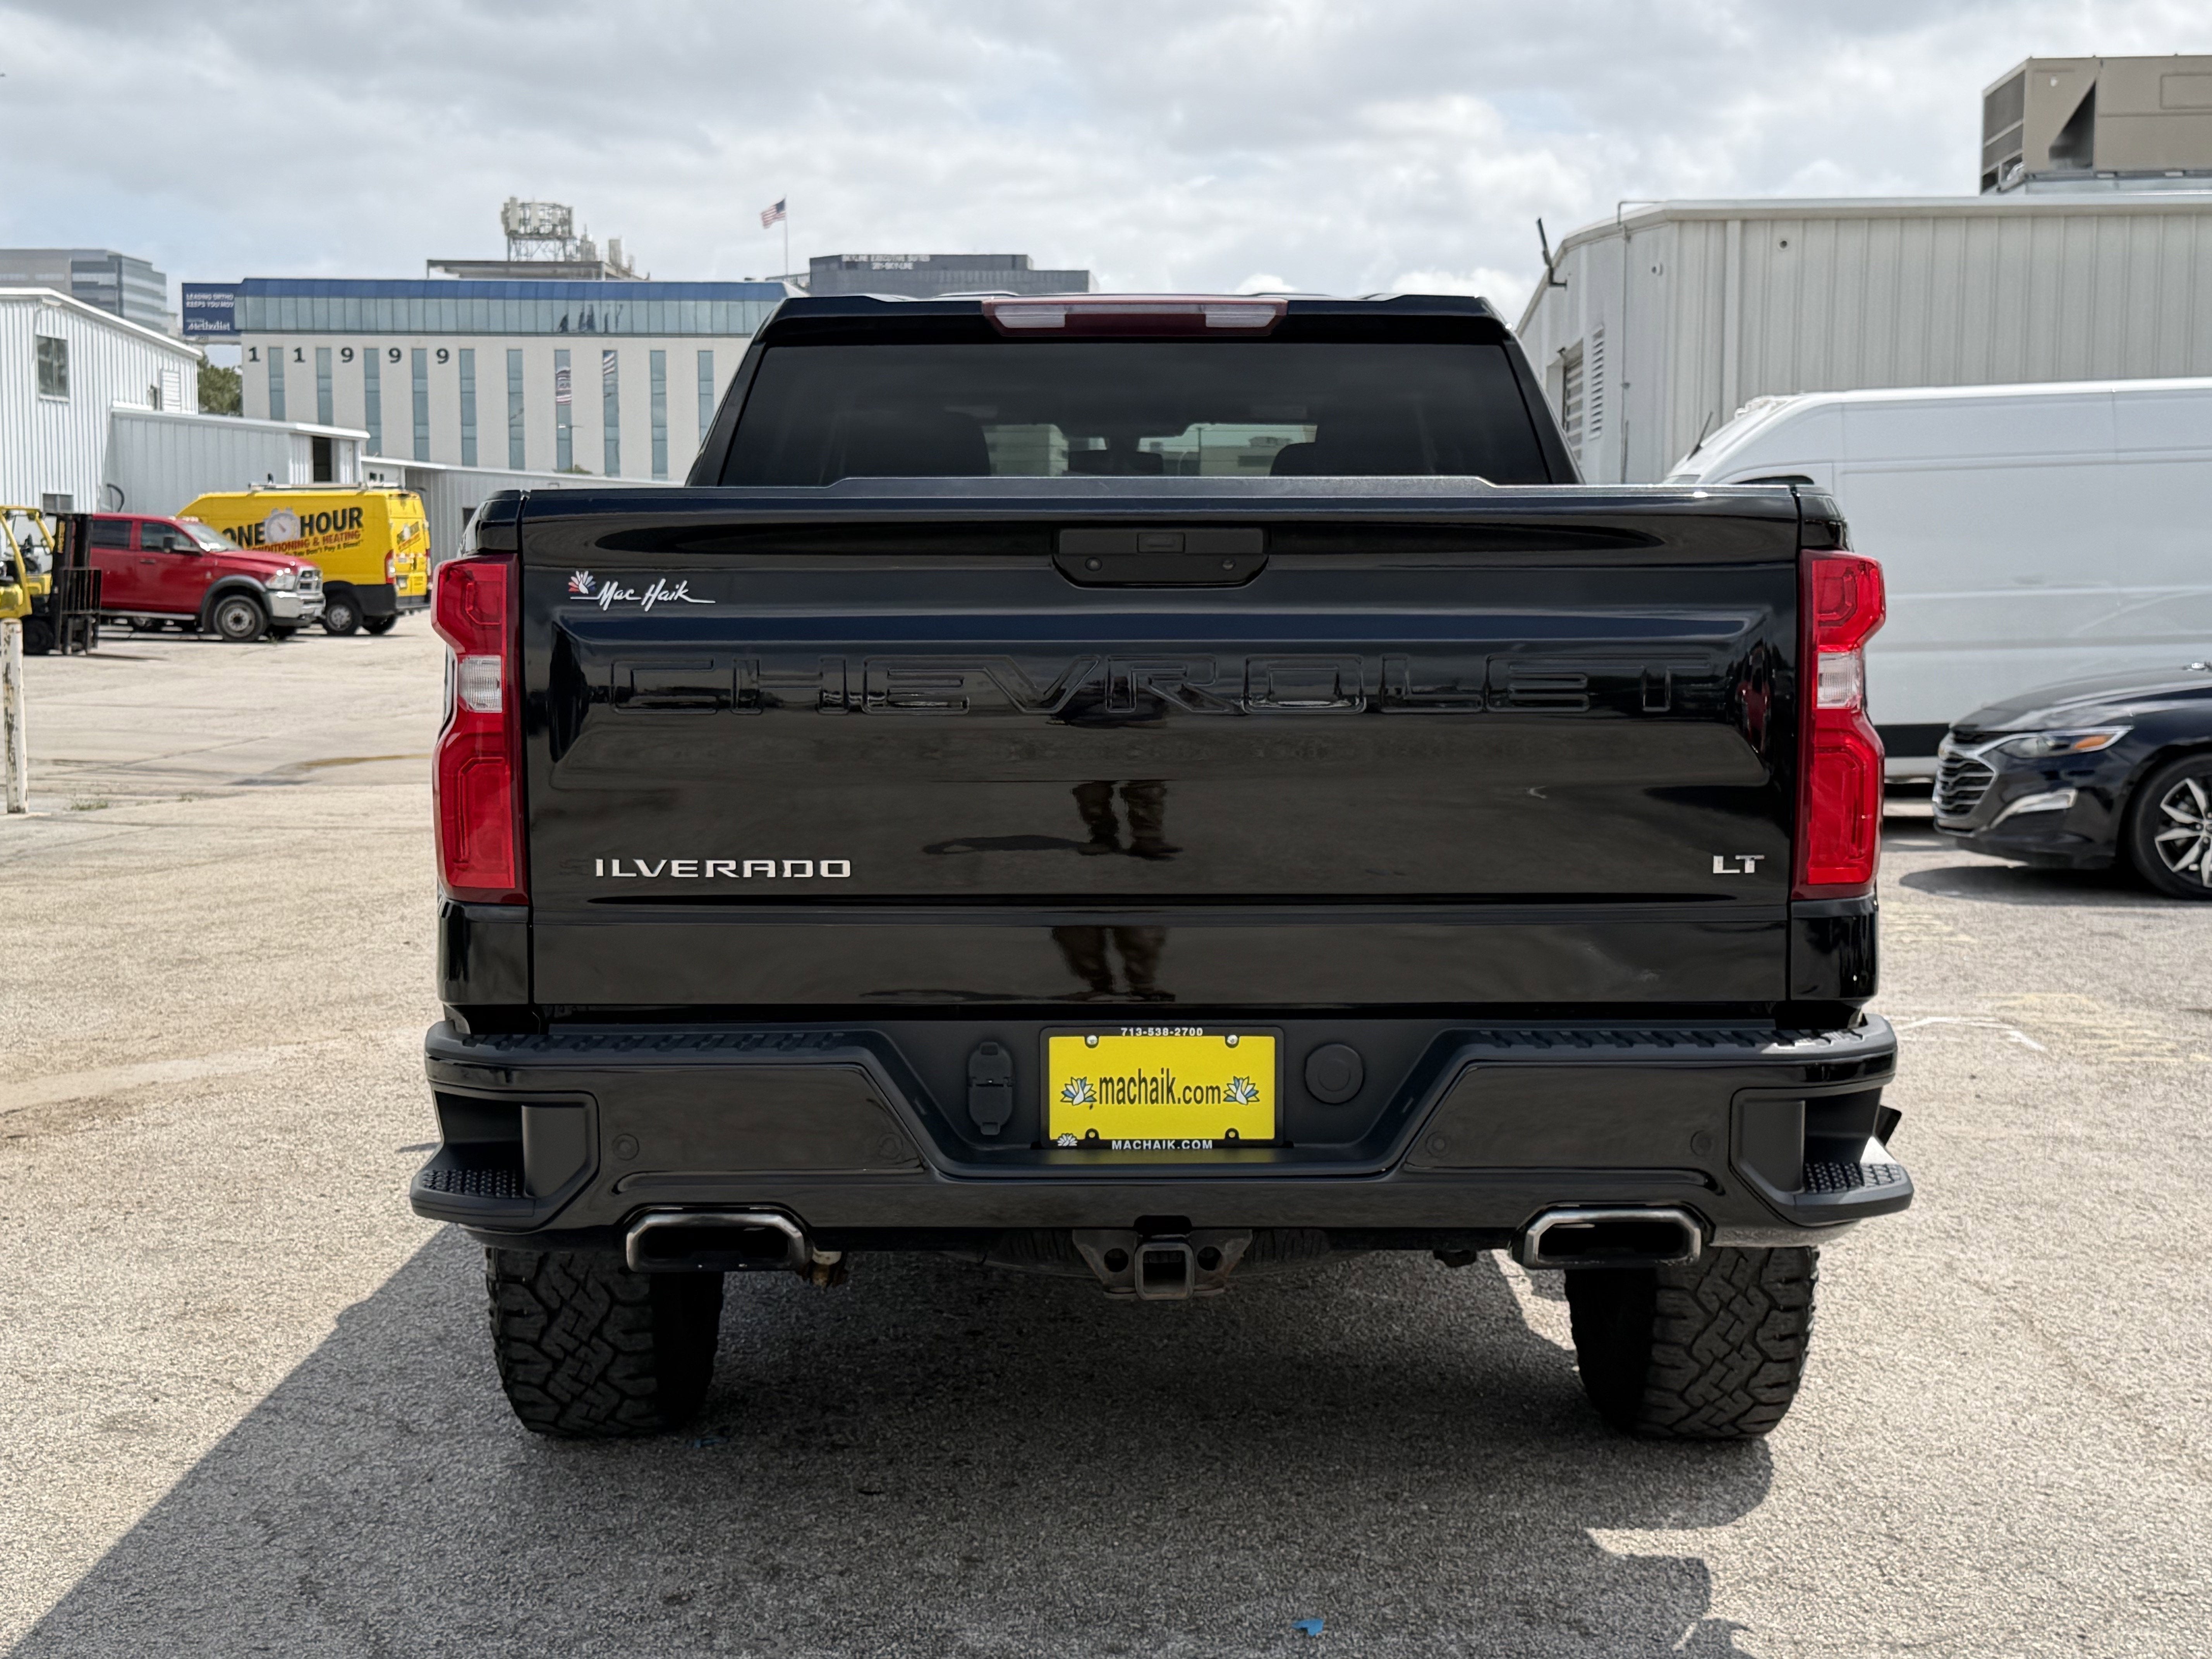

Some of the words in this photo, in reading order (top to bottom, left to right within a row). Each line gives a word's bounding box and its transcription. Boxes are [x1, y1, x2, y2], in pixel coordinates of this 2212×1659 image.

[300, 507, 364, 538] HOUR
[313, 537, 319, 546] &
[323, 529, 361, 545] HEATING
[596, 581, 641, 611] Mac
[641, 578, 716, 612] Haik
[609, 653, 1714, 716] CHEVROLET
[595, 859, 851, 878] ILVERADO
[1713, 854, 1765, 874] LT
[1121, 1027, 1203, 1036] 713-538-2700
[1099, 1067, 1221, 1105] machaik.com
[1111, 1140, 1213, 1150] MACHAIK.COM
